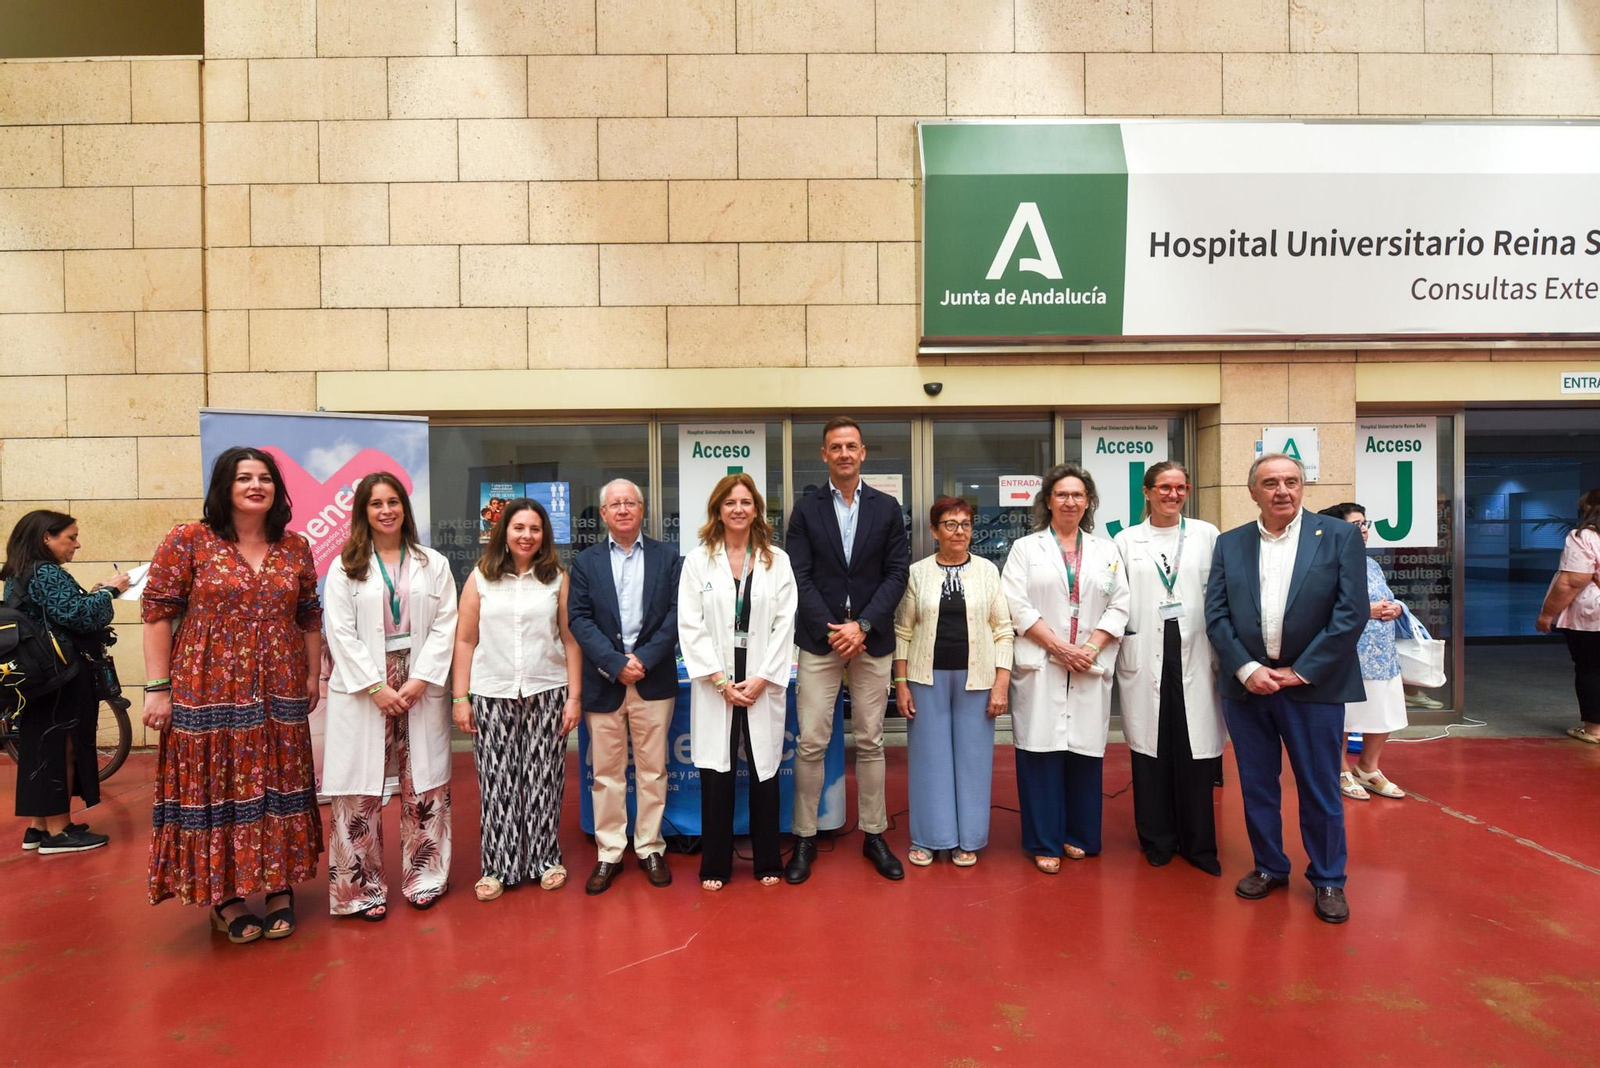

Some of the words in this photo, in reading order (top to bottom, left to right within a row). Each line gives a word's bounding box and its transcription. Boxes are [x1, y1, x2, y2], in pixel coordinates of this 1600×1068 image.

[1150, 228, 1278, 264] Hospital
[1287, 228, 1485, 257] Universitario
[1493, 228, 1576, 256] Reina
[940, 289, 990, 305] Junta
[994, 288, 1016, 305] de
[1019, 286, 1107, 305] Andalucía
[1411, 276, 1537, 300] Consultas
[1545, 277, 1599, 300] Exte
[1563, 377, 1600, 388] ENTR
[692, 441, 751, 458] Acceso
[1096, 436, 1153, 454] Acceso
[1365, 436, 1422, 453] Acceso
[1374, 461, 1413, 541] J
